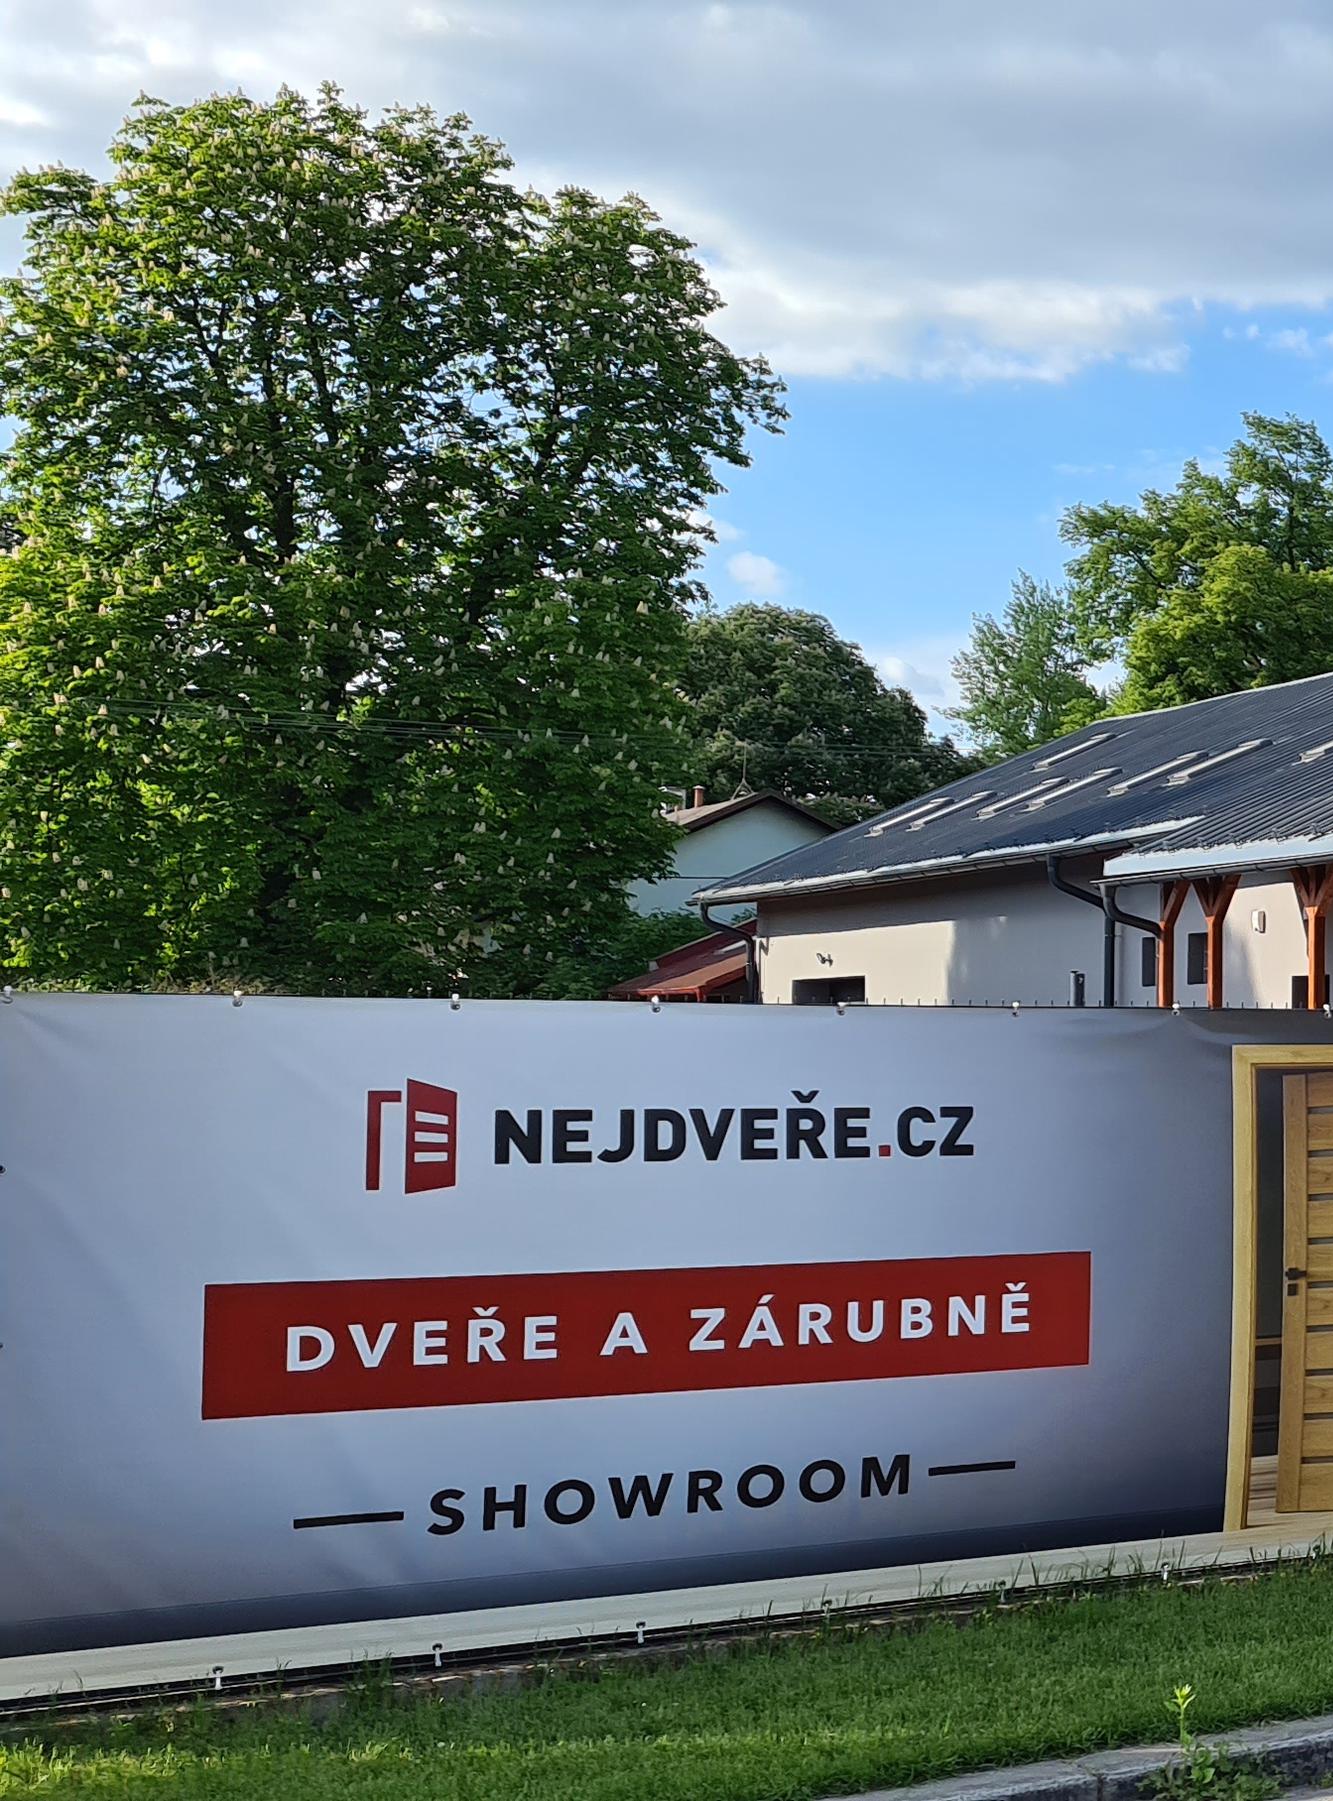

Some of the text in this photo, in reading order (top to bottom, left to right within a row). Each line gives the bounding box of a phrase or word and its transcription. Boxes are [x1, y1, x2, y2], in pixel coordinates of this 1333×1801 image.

[494, 1090, 975, 1165] NEJDVEŘE.CZ
[286, 1281, 1031, 1372] DVEŘE A ZÁRUBNĚ
[427, 1455, 912, 1536] SHOWROOM
